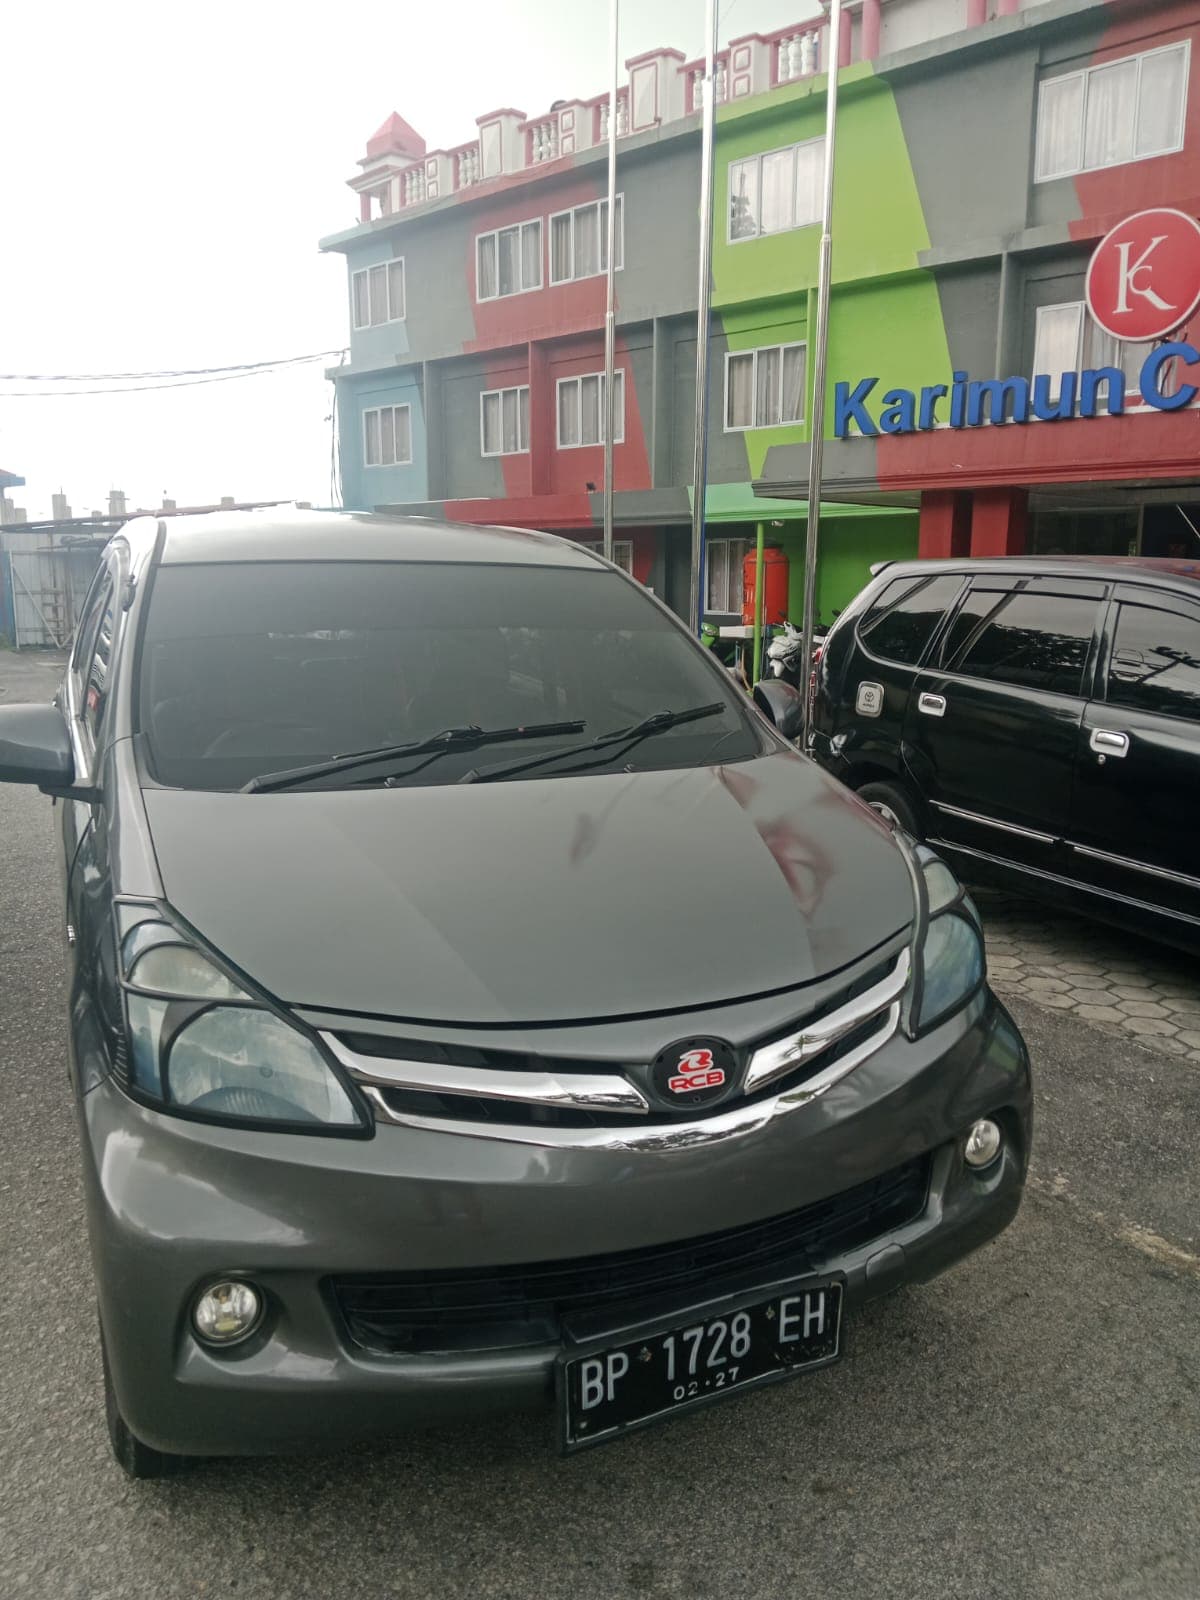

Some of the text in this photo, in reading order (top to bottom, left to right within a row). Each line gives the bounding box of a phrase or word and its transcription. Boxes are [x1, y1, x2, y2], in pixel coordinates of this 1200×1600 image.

[833, 366, 1126, 438] Karimun
[668, 1069, 725, 1093] RCB
[581, 1291, 825, 1411] BP 1728 EH
